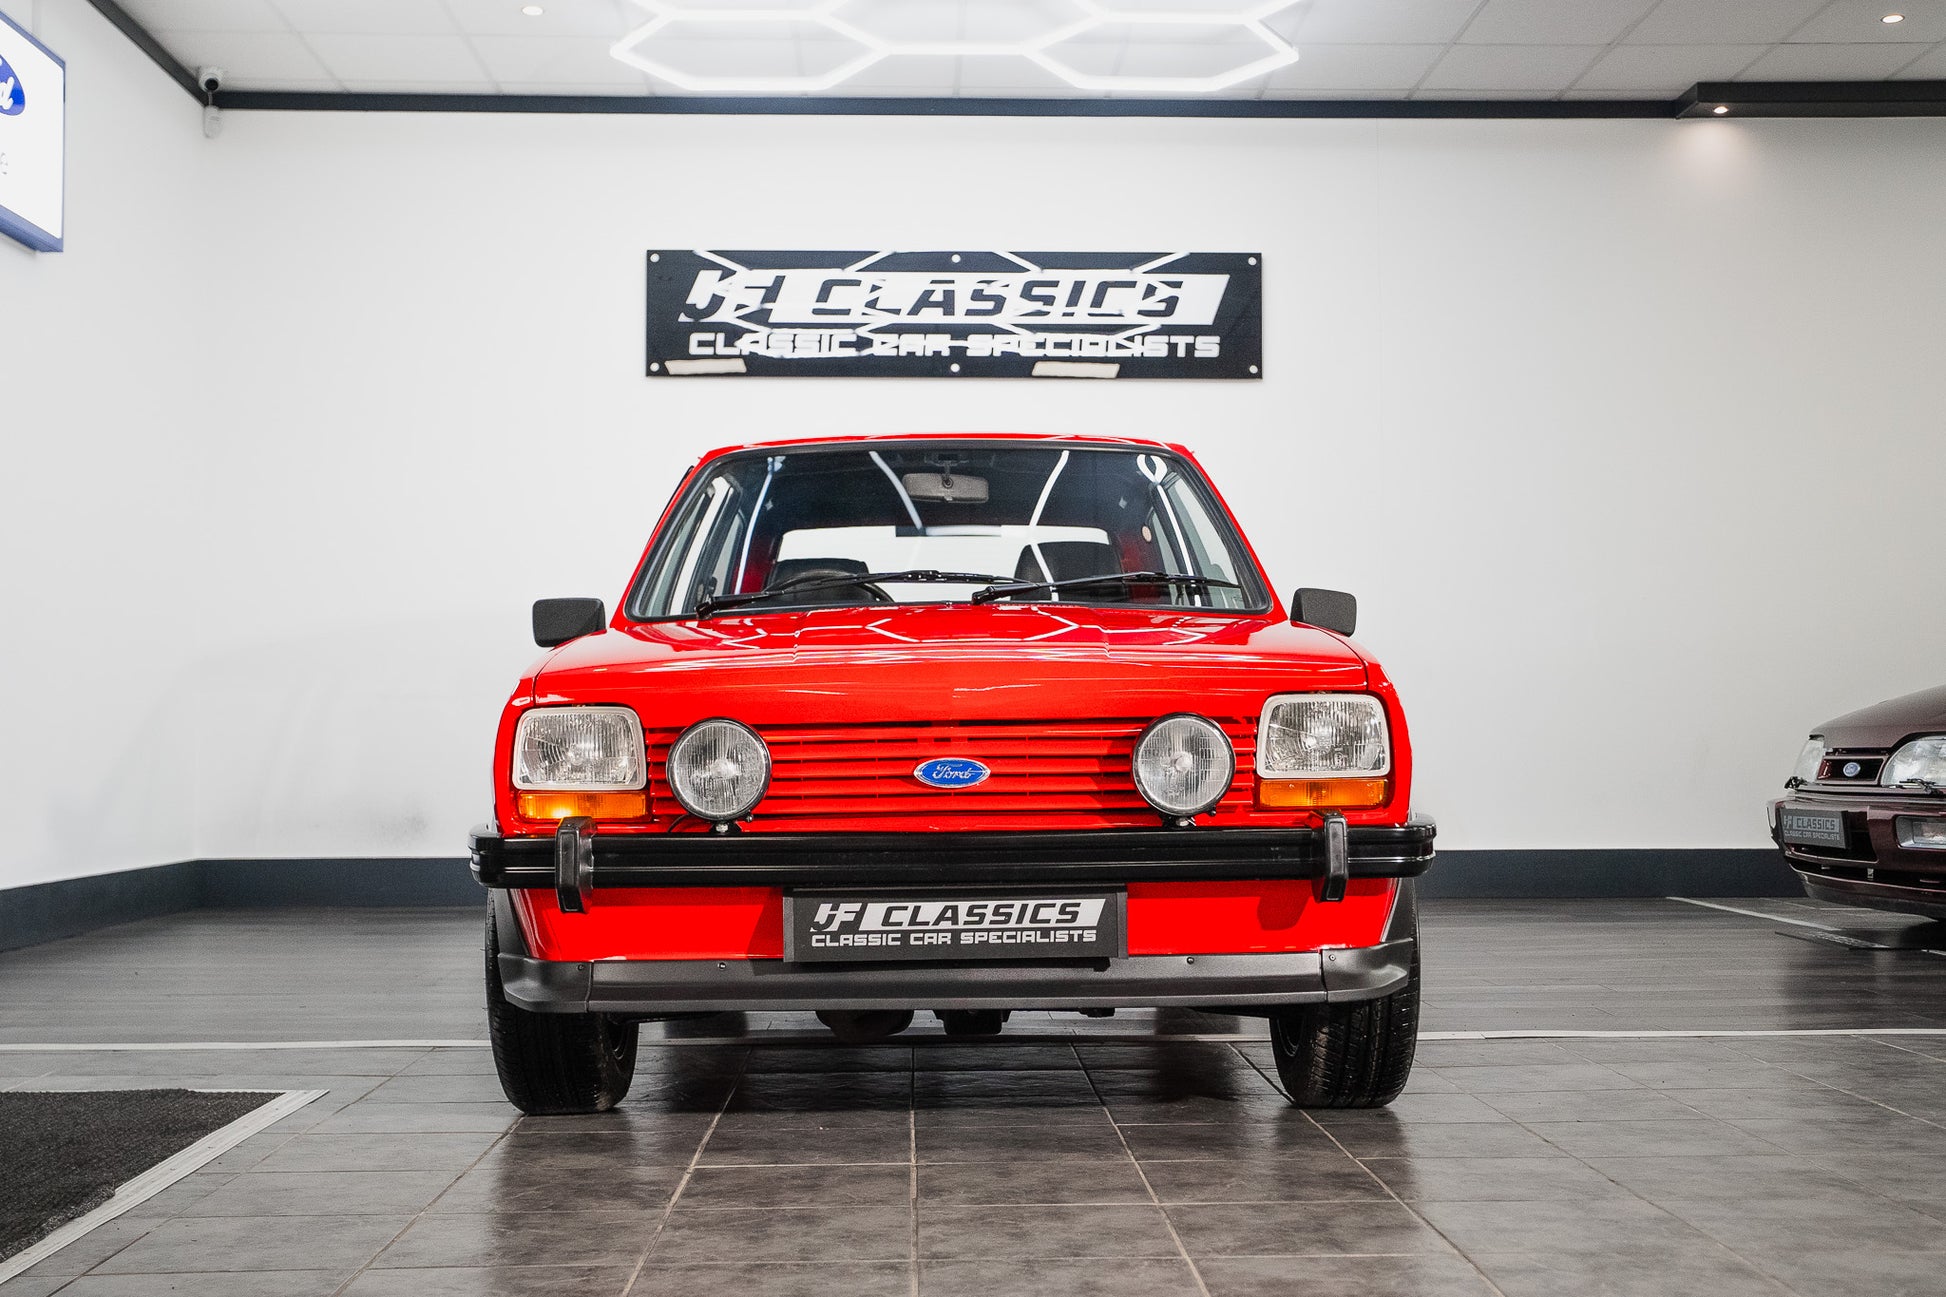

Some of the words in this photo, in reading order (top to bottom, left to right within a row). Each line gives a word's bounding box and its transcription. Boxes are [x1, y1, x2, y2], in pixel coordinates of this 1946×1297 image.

[812, 278, 1184, 318] CLASSICS
[932, 764, 973, 779] Ford
[1796, 817, 1836, 831] CLASSICS
[810, 902, 862, 932] JF
[880, 901, 1082, 927] CLASSICS
[811, 933, 901, 947] CLASSIC
[909, 931, 951, 946] CAR
[960, 929, 1097, 945] SPECIALISTS
